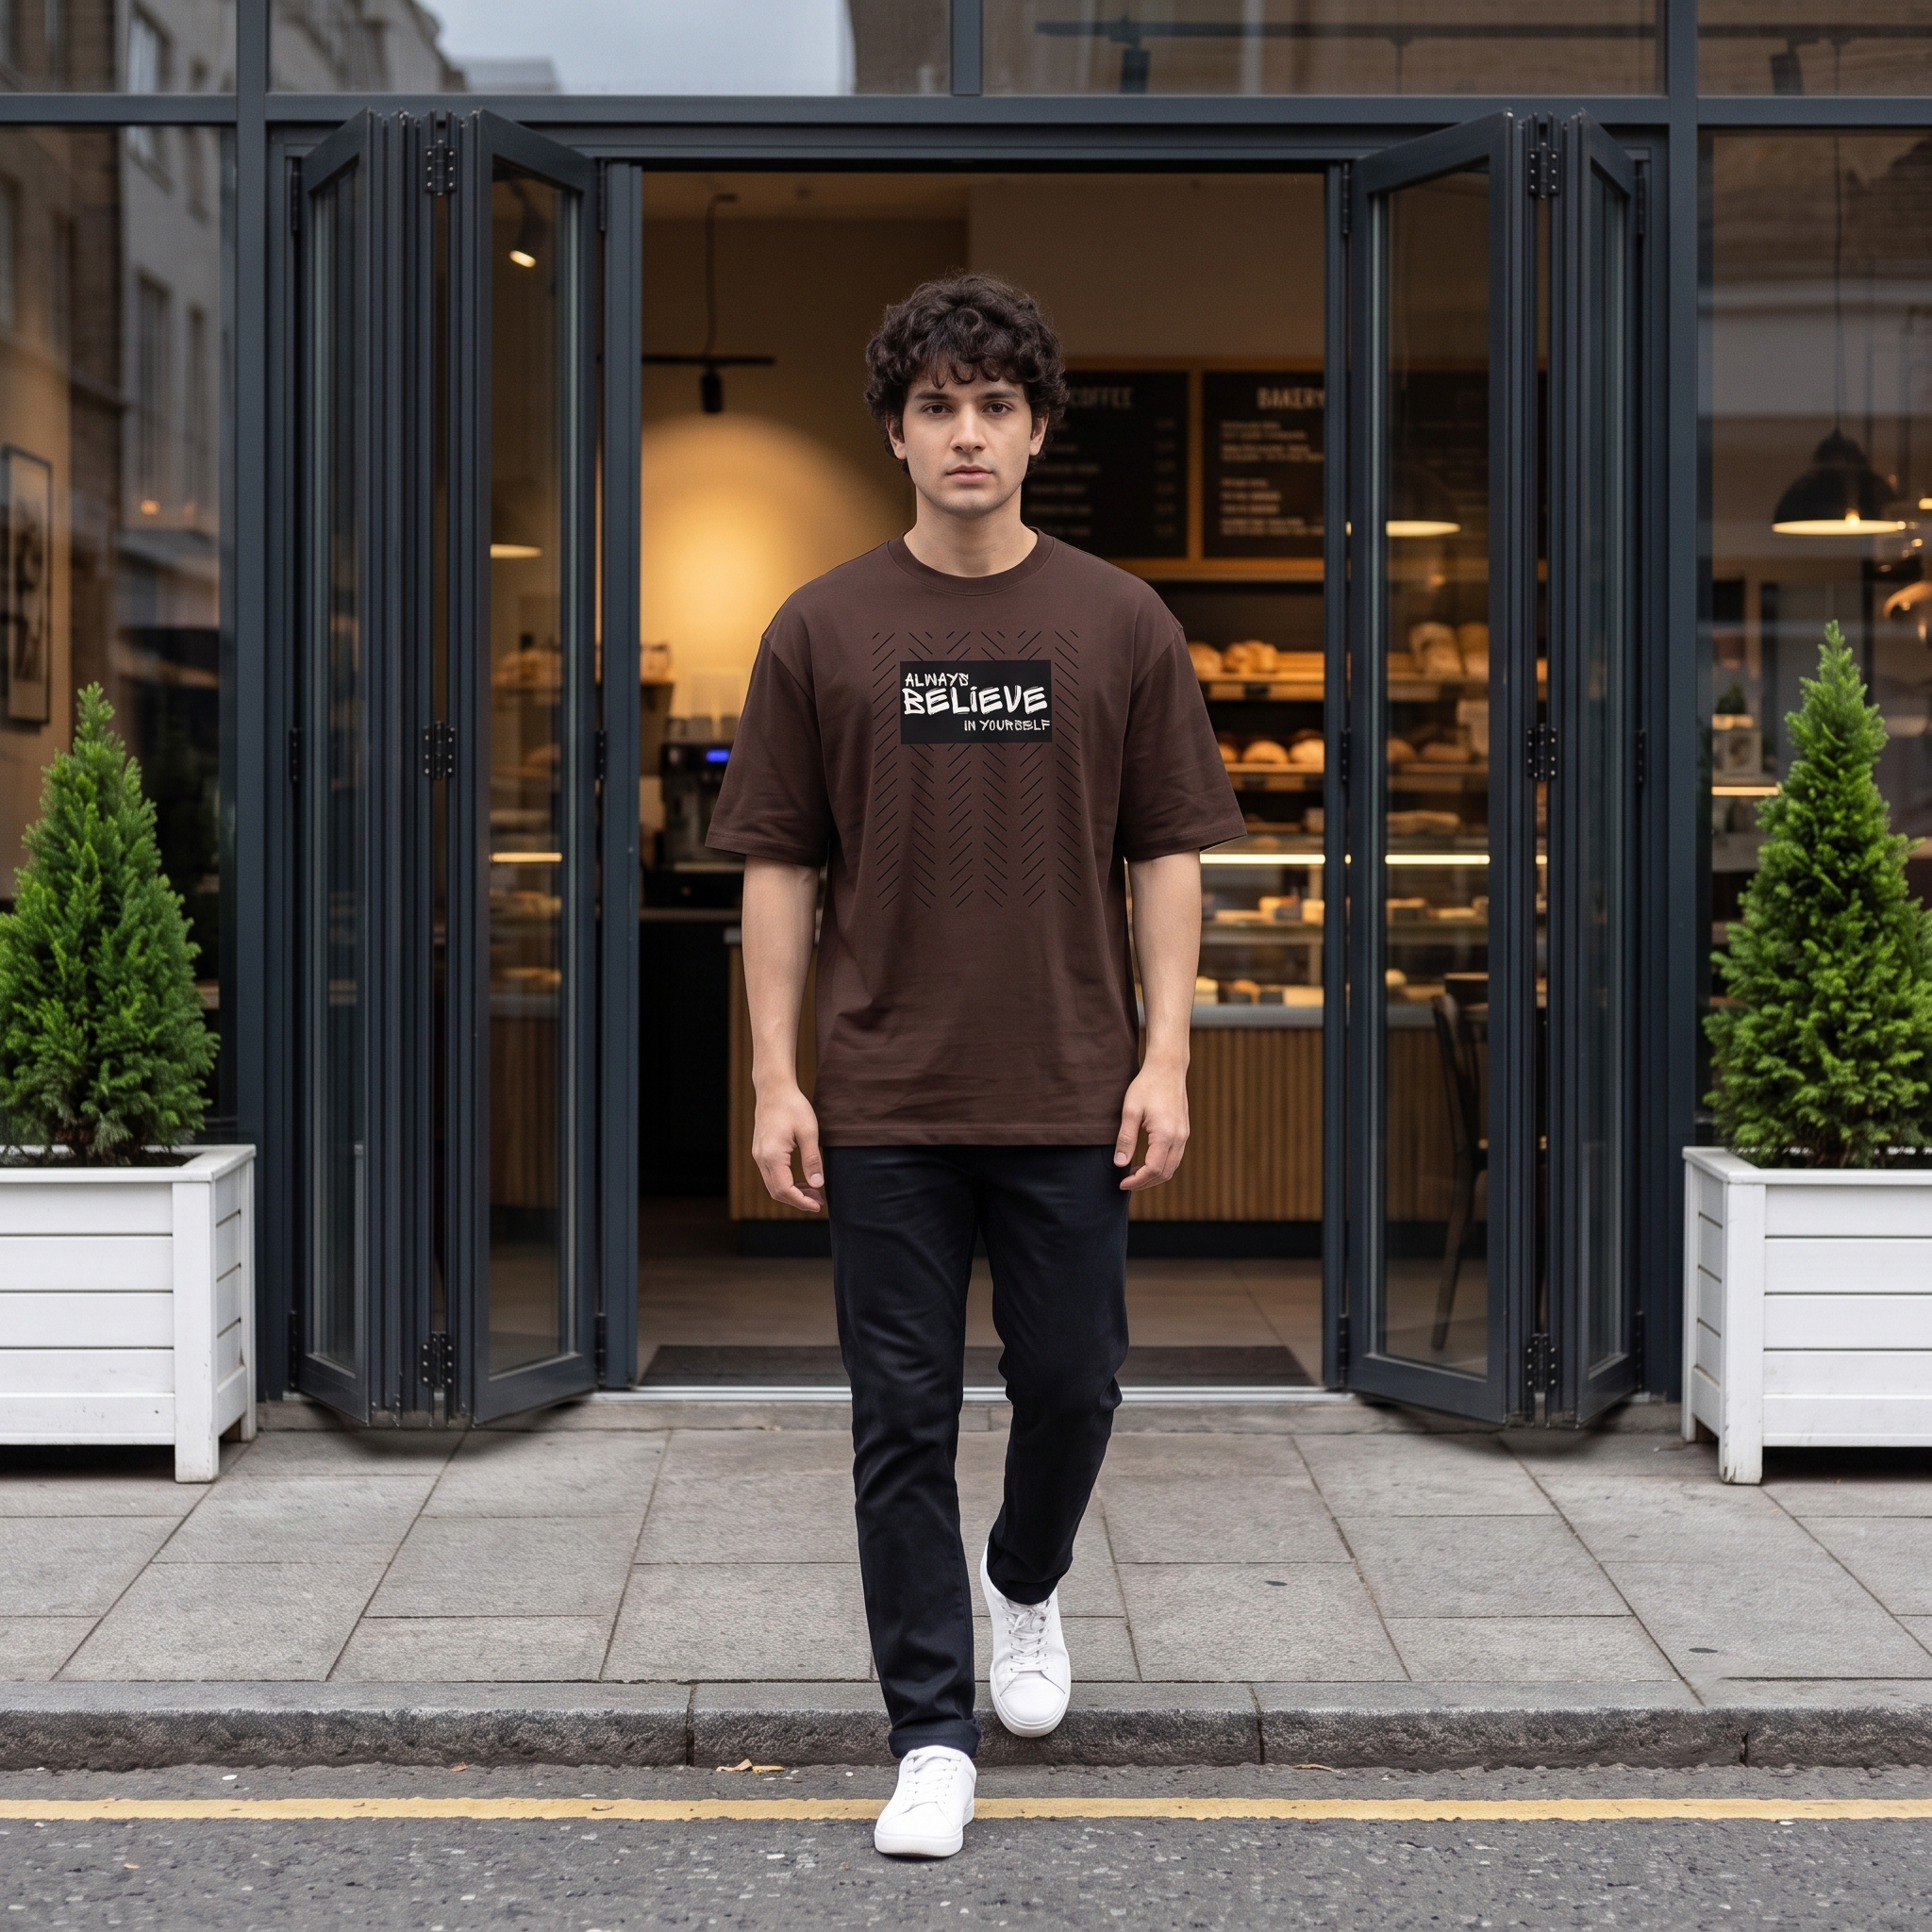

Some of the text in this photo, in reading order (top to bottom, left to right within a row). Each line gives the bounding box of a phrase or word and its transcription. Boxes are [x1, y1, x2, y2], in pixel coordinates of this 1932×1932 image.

[905, 673, 969, 687] ALWAYS
[964, 719, 1050, 731] IN YOURSELF
